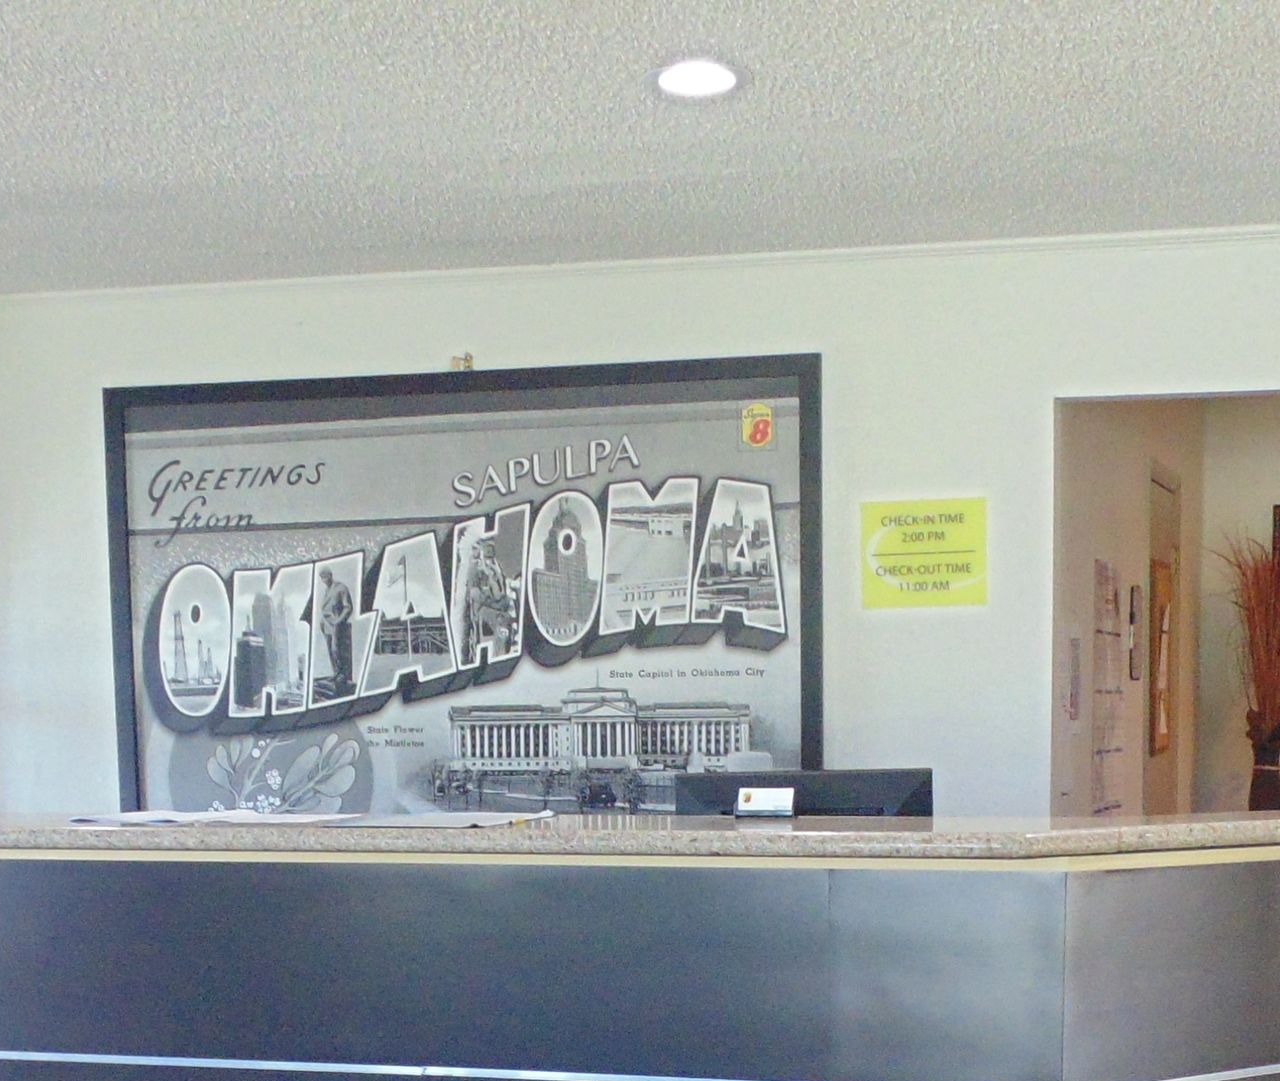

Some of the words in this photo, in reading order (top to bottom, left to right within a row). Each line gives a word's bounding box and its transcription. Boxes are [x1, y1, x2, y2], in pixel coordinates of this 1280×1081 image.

[749, 418, 770, 446] 8
[452, 434, 640, 507] SAPULPA
[148, 460, 325, 516] GREETINGS
[154, 496, 257, 549] from
[881, 515, 935, 527] CHECK-IN
[939, 513, 965, 524] TIME
[902, 532, 925, 543] 2:00
[927, 531, 945, 541] PM
[875, 564, 942, 576] CHECK-OUT
[946, 563, 971, 574] TIME
[900, 581, 928, 592] 11:00
[931, 580, 950, 591] AM
[152, 477, 787, 722] OKLAHOMA
[609, 669, 634, 679] State
[638, 669, 673, 680] Capitol
[677, 669, 687, 678] in
[691, 668, 740, 678] Oklahoma
[745, 667, 765, 678] City
[367, 725, 389, 734] State
